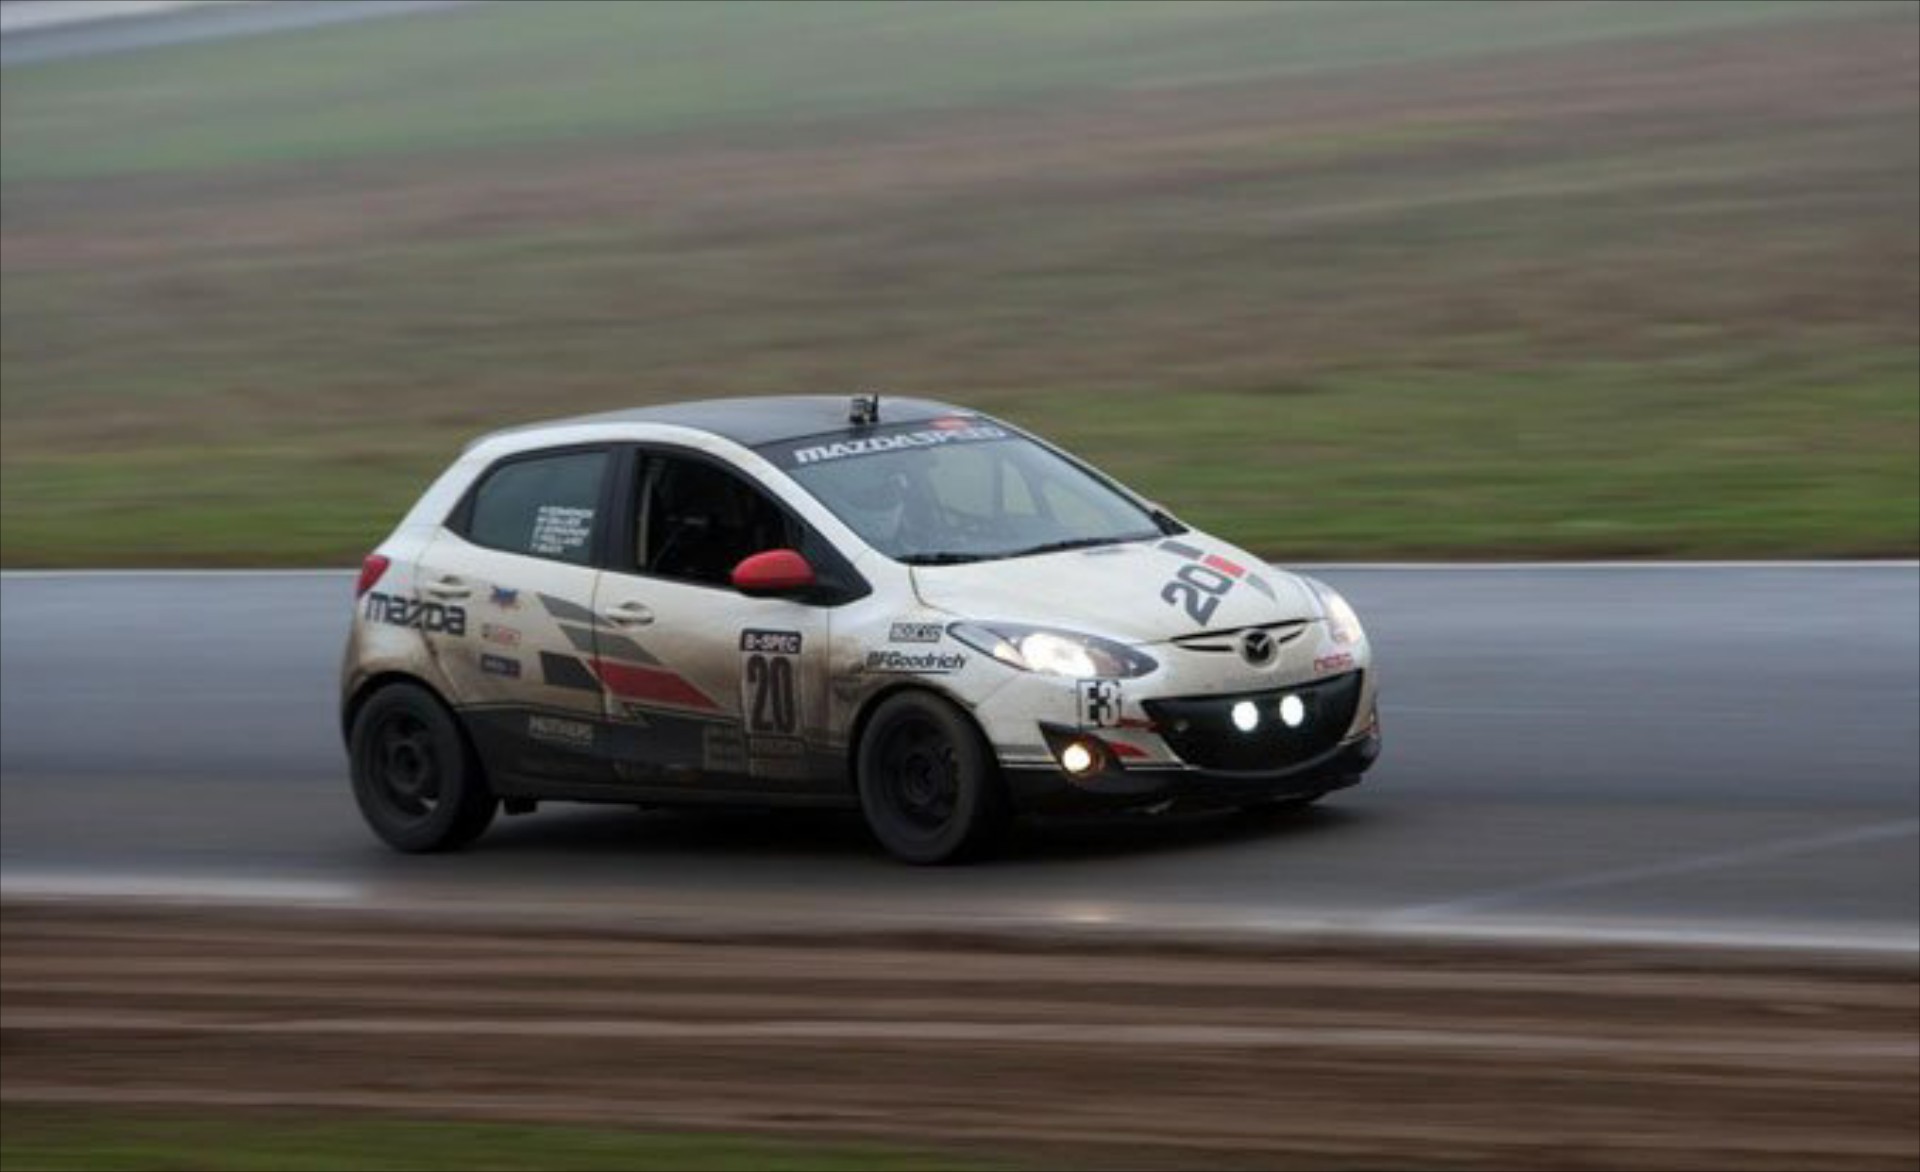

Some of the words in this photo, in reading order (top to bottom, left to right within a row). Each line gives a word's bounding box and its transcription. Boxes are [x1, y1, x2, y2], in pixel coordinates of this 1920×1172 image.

[1161, 563, 1235, 626] 20
[743, 633, 799, 652] B-SPEC
[866, 651, 967, 670] BFGoodrich
[748, 654, 795, 734] 20
